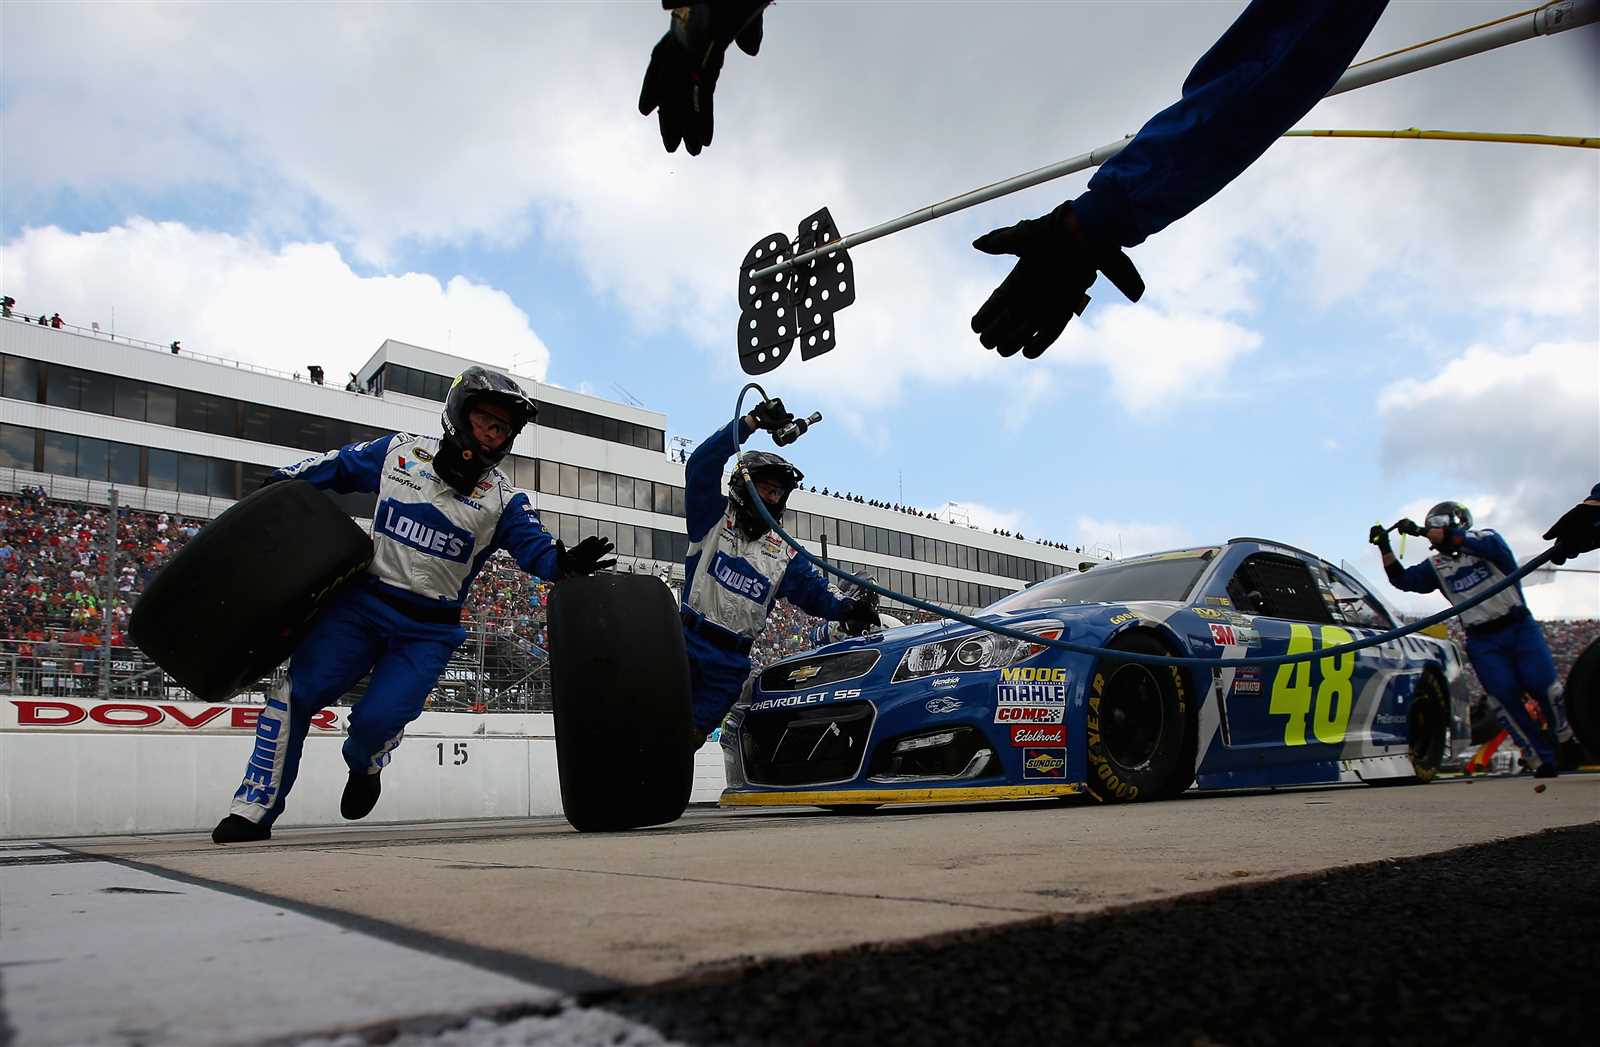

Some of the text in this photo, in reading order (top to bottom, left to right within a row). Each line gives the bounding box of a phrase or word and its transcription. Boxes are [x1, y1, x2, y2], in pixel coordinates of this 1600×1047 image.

[384, 506, 465, 558] LOWE'S
[714, 556, 766, 599] LOWE'S
[1211, 624, 1236, 646] 3M
[1000, 667, 1067, 682] MOOG
[1268, 623, 1355, 747] 48
[750, 688, 862, 711] CHEVROLET SS
[999, 686, 1065, 702] MAHLE
[10, 700, 339, 730] DOVER
[997, 707, 1050, 721] COMP
[1014, 729, 1062, 743] Edelbrock
[1087, 672, 1139, 801] GOODYEAR
[436, 742, 469, 766] 15
[1026, 759, 1063, 768] SUNOCO
